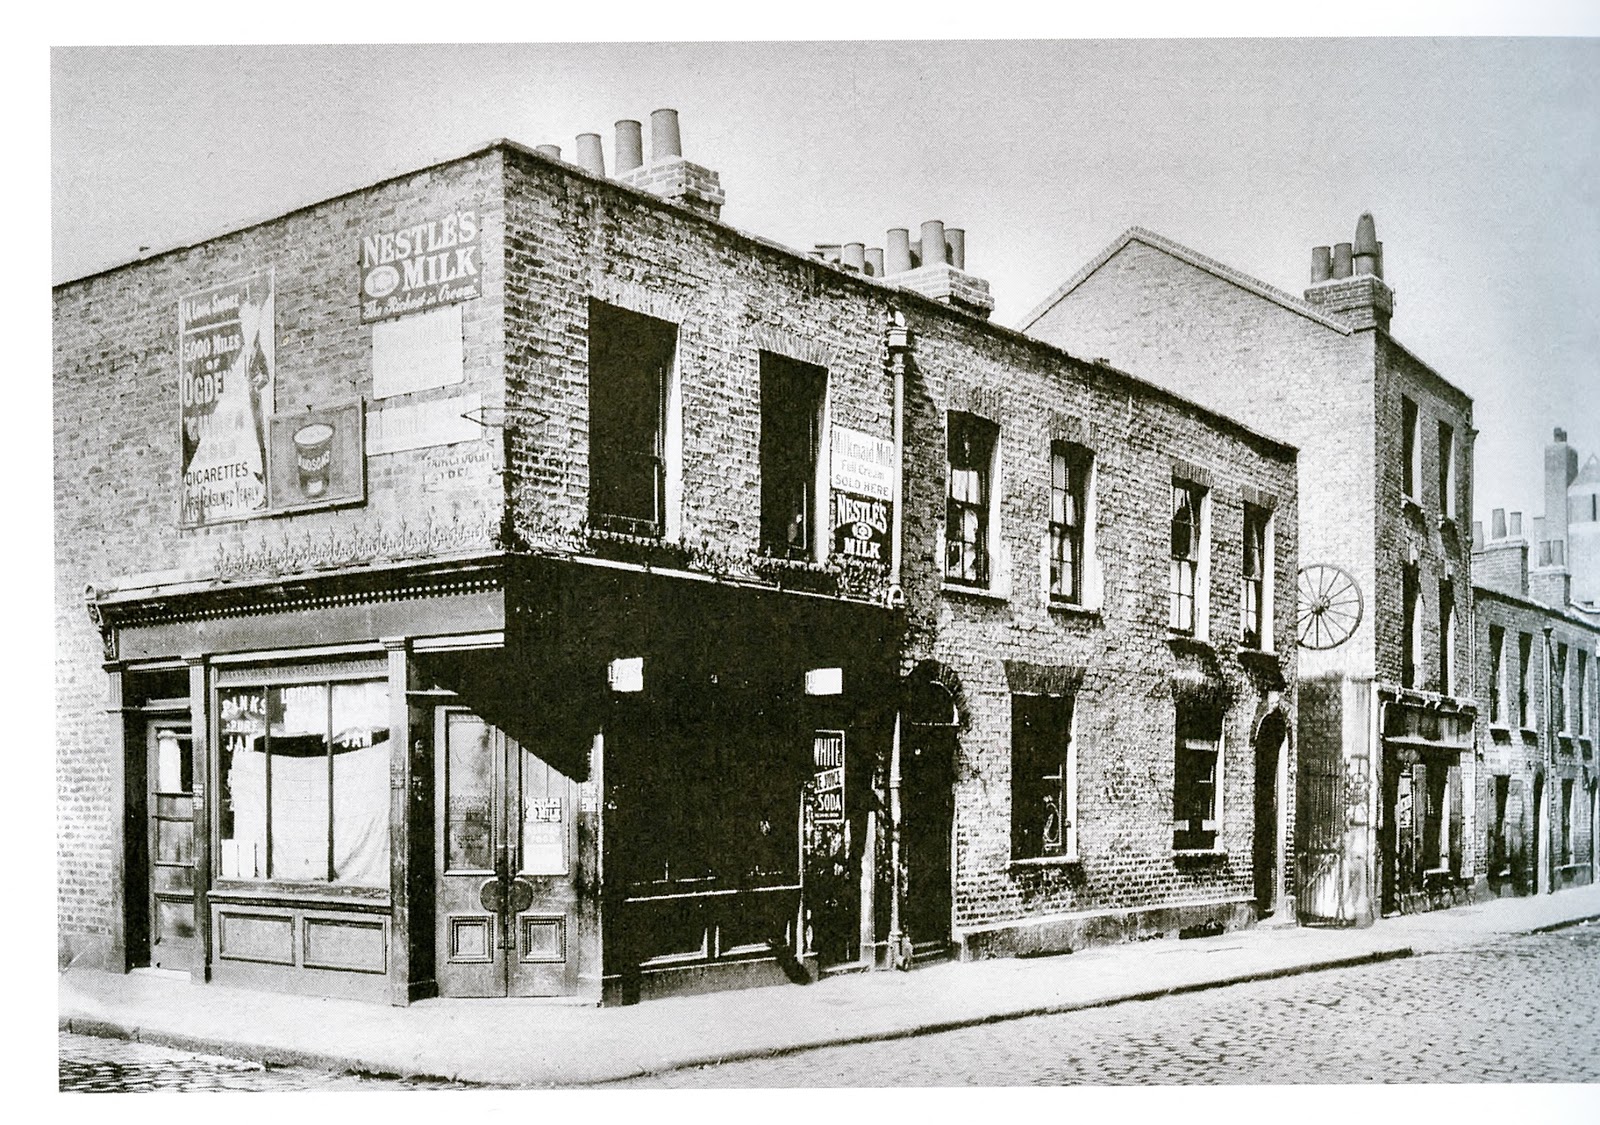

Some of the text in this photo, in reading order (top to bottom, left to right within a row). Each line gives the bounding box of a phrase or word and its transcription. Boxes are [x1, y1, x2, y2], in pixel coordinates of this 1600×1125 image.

[402, 245, 478, 292] MILK
[835, 474, 889, 497] SOLD HERE
[843, 537, 881, 559] MILK
[818, 794, 842, 811] SODA
